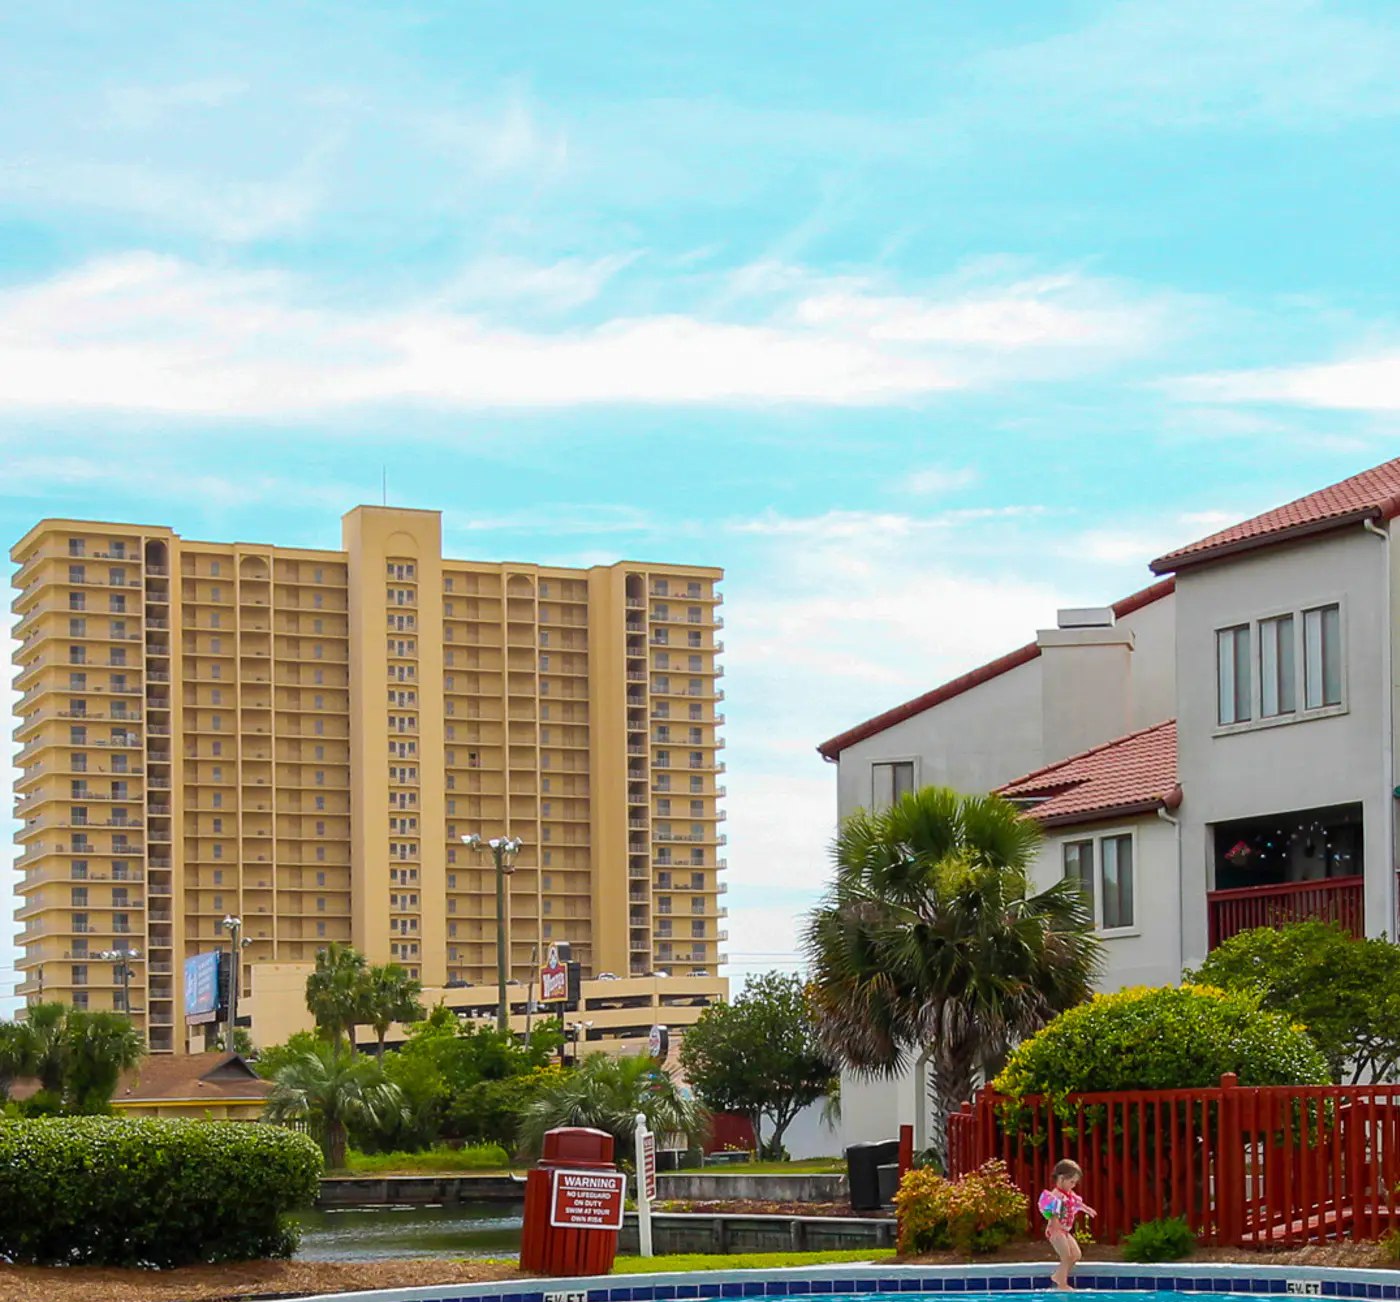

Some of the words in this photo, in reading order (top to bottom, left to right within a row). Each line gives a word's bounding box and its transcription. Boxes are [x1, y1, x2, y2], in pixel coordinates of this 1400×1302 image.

[564, 1176, 616, 1188] WARNING
[577, 1191, 611, 1199] LIFEGUARD
[593, 1208, 610, 1216] YOUR
